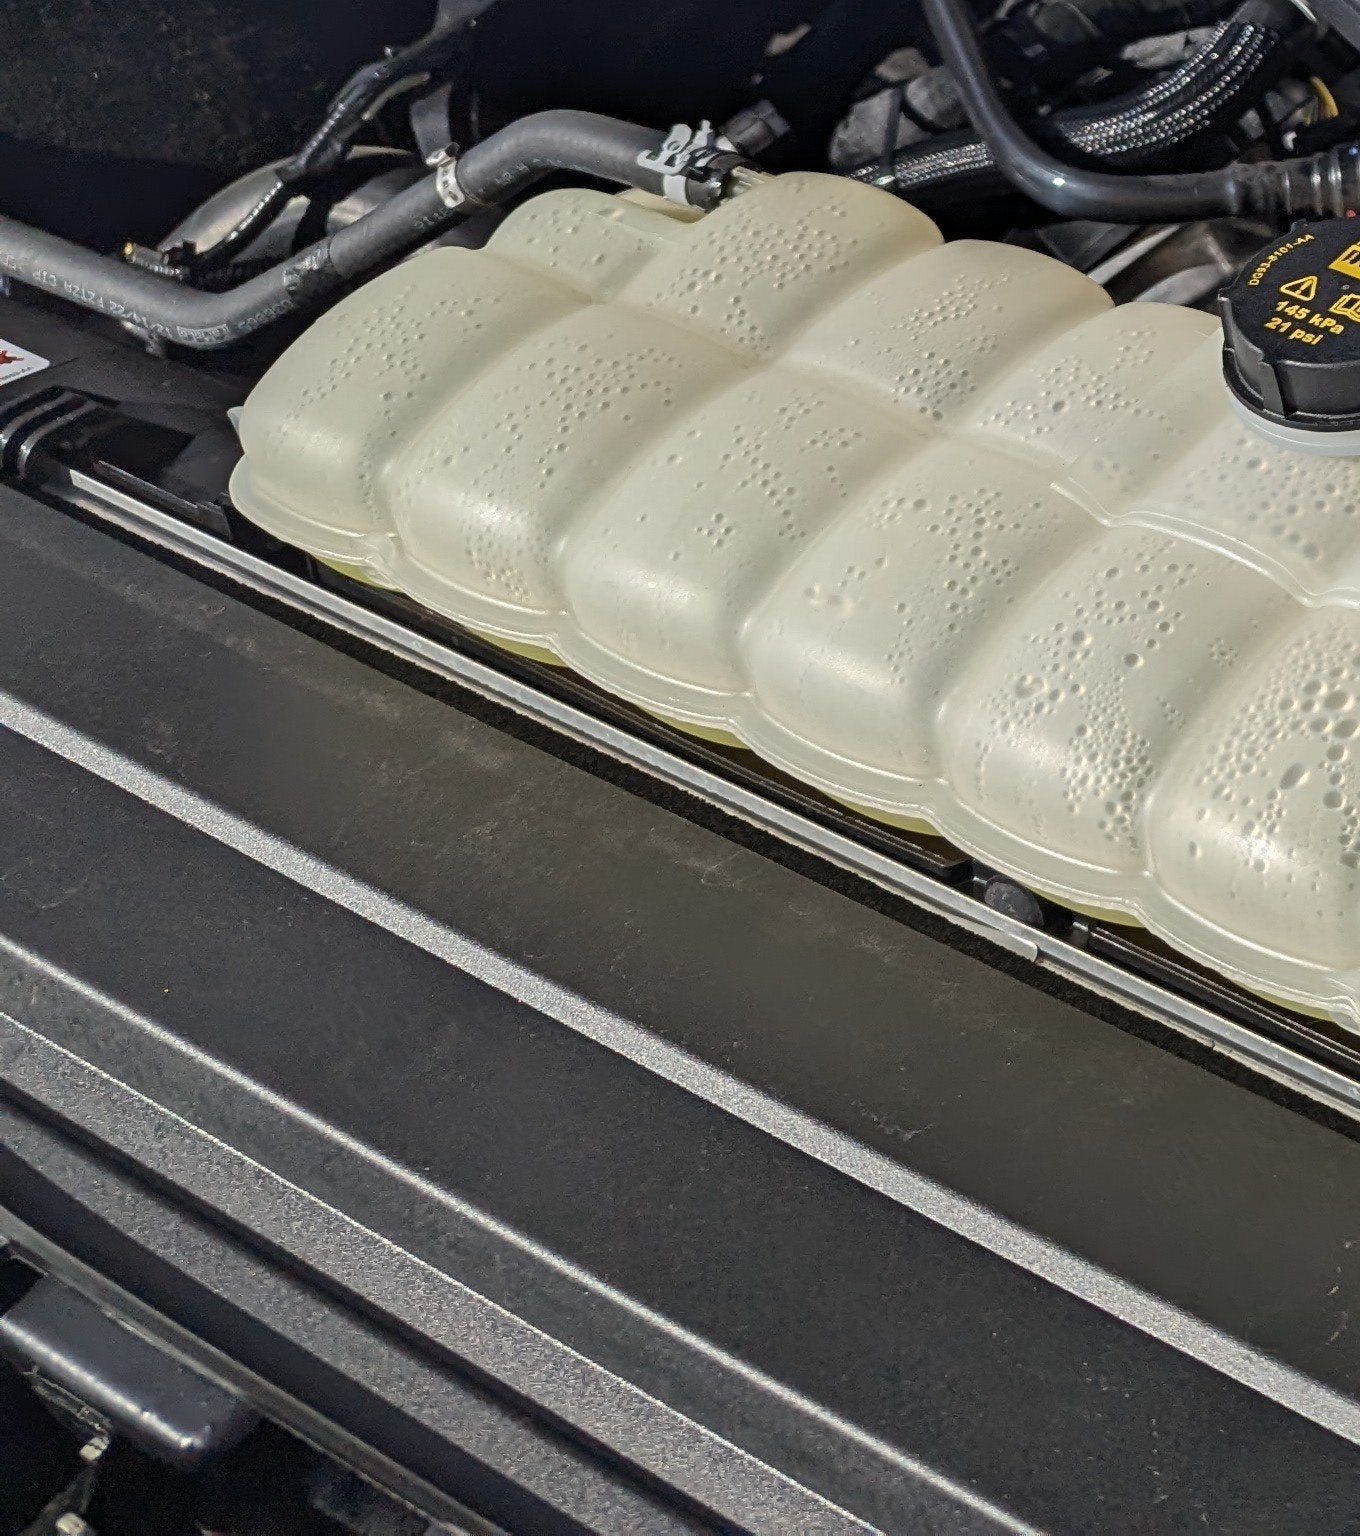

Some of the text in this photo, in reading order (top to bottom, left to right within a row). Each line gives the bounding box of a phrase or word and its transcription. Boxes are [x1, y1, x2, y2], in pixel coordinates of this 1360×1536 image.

[1264, 317, 1324, 345] 21 psi
[1275, 301, 1345, 334] 145 kPa
